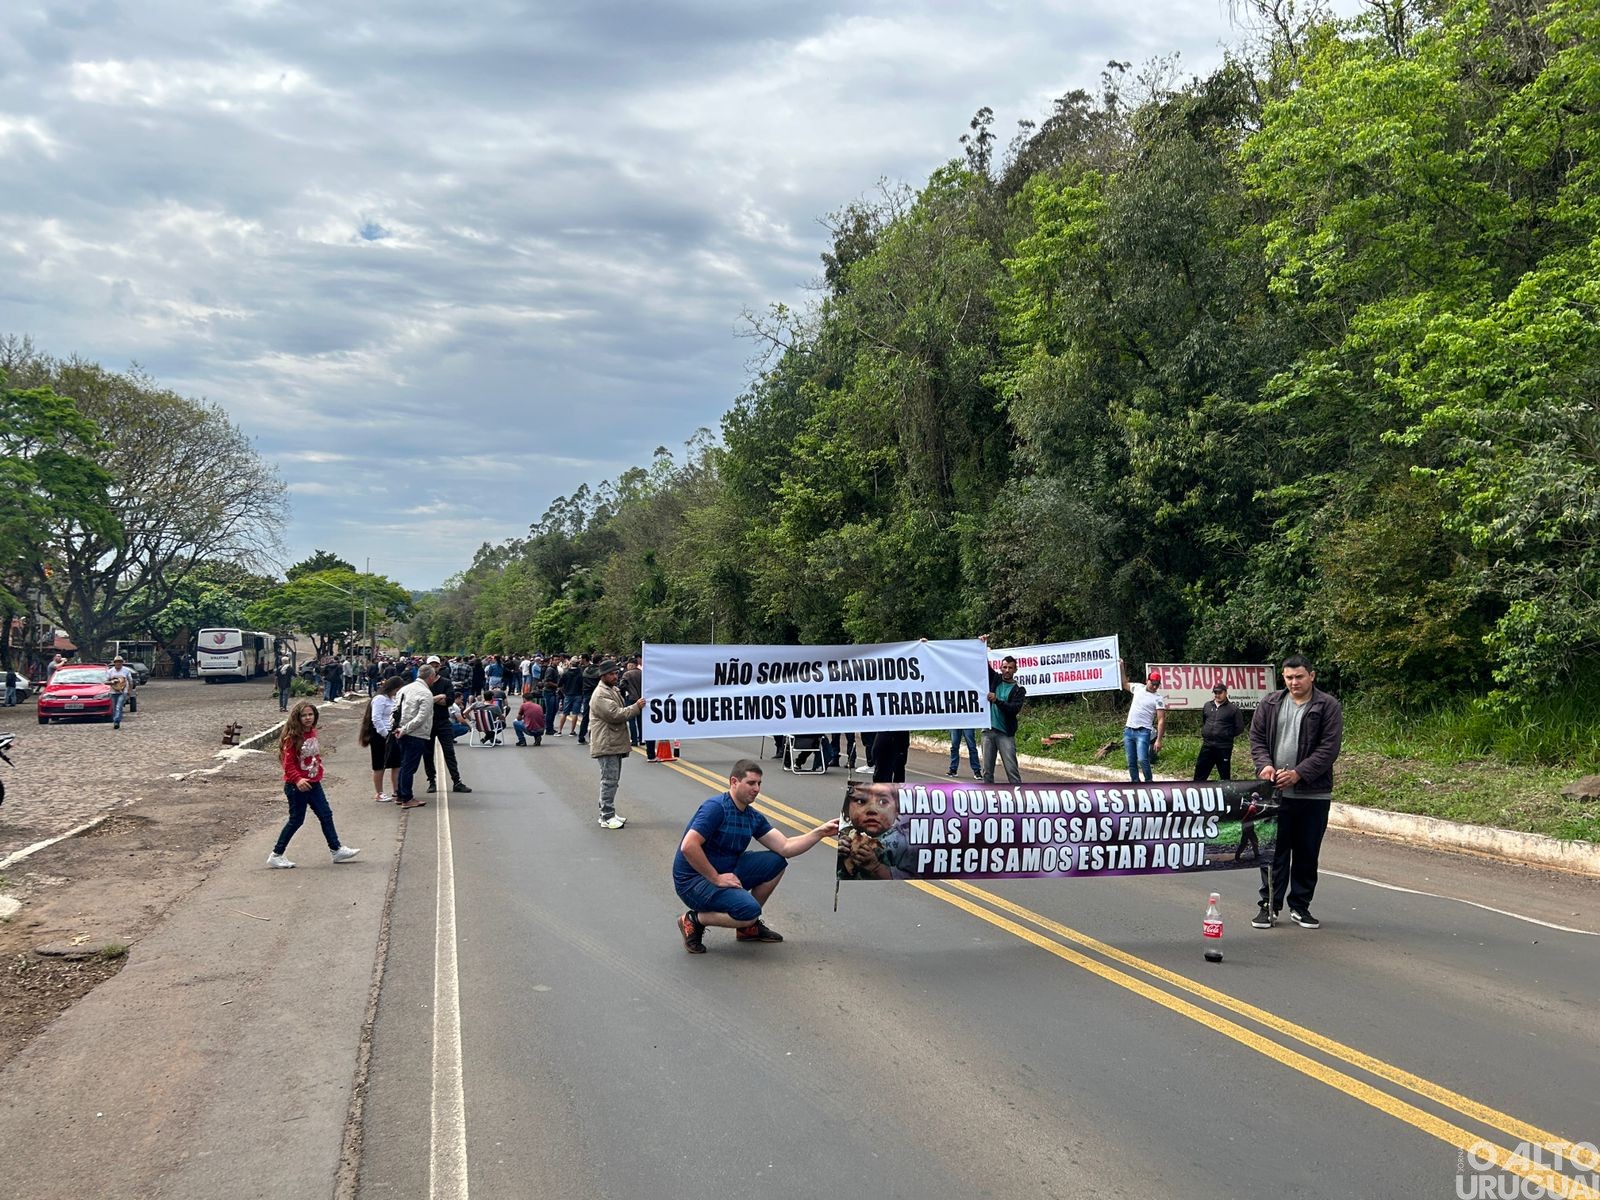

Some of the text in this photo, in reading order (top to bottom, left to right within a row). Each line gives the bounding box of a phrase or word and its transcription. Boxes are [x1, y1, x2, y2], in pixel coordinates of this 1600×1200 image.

[713, 657, 925, 686] NÃO SOMOS BANDIDOS,
[1040, 648, 1113, 666] DESAMPARADOS.
[1038, 672, 1051, 685] AO
[1052, 667, 1103, 684] TRABALHO!
[650, 690, 984, 725] SÓ QUEREMOS VOLTAR A TRABALHAR.
[898, 786, 1232, 817] NÃO QUERÍAMOS ESTAR AQUI,
[909, 812, 1221, 845] MAS POR NOSSAS FAMÍLIAS
[916, 843, 1211, 874] PRECISAMOS ESTAR AQUI.
